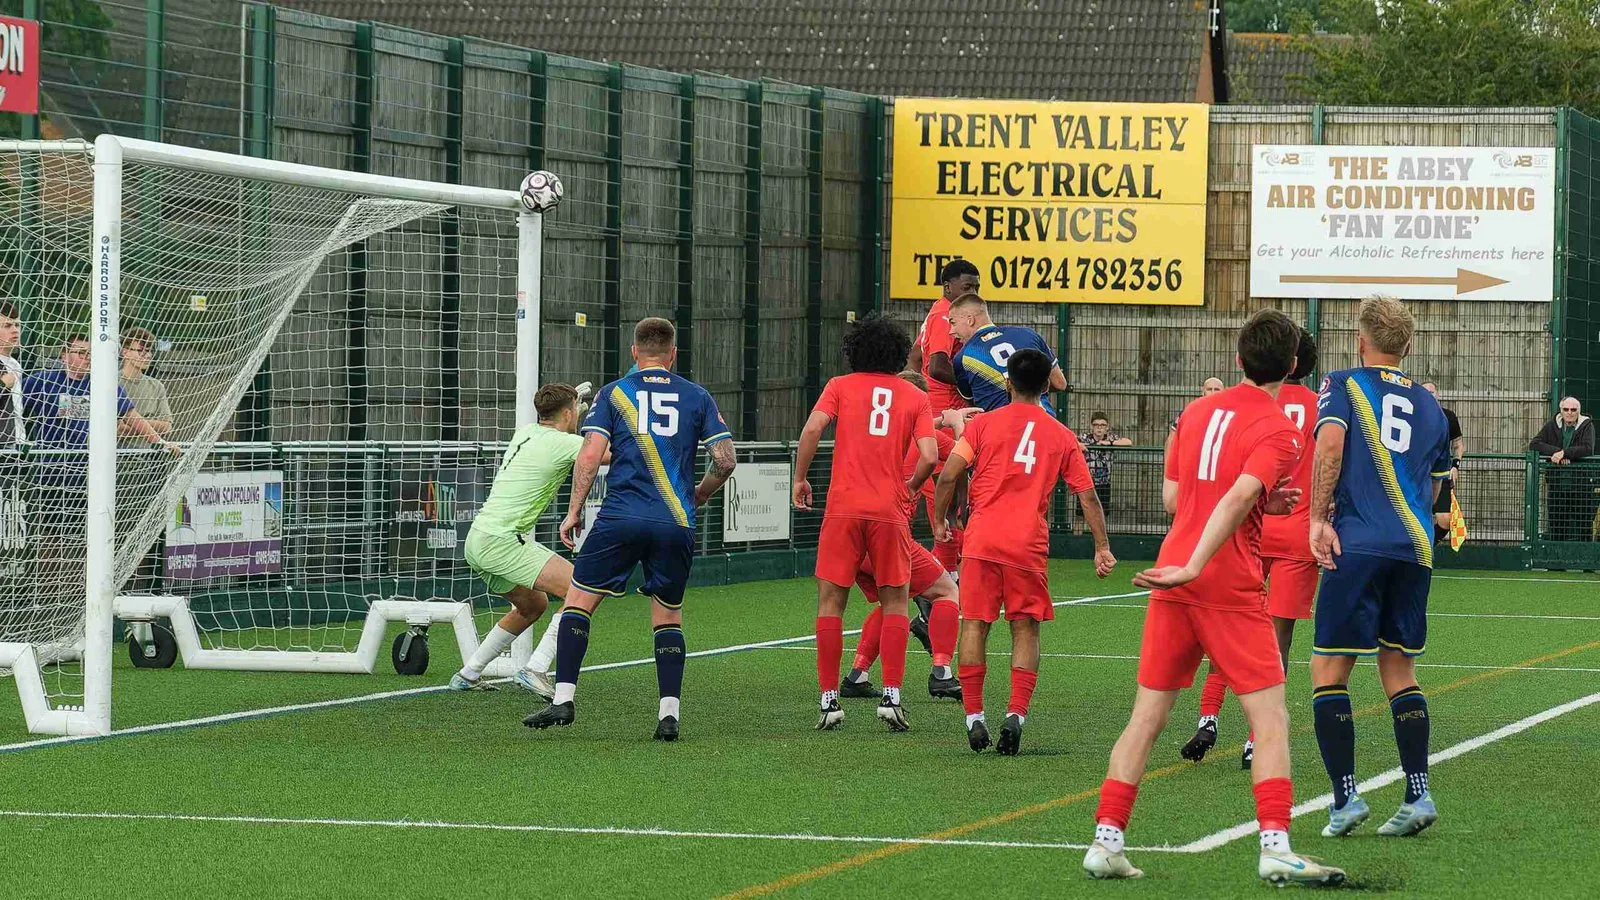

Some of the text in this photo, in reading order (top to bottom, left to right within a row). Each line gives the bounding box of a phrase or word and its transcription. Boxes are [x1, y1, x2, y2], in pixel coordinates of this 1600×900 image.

[915, 111, 1189, 152] TRENT VALLEY
[936, 161, 1162, 199] ELECTRICAL
[1329, 156, 1388, 180] THE
[1397, 157, 1474, 181] ABEY
[1266, 185, 1535, 211] AIR CONDITIONING
[959, 205, 1138, 243] SERVICES
[1257, 244, 1545, 260] Get your Alcoholic Refreshments here
[100, 246, 110, 331] HARROD SPORT
[913, 253, 1183, 292] TE 01724 782356
[1381, 370, 1413, 389] MKM
[636, 390, 680, 437] 15
[869, 386, 893, 436] 8
[1380, 392, 1414, 453] 6
[1013, 421, 1037, 474] 4
[1197, 408, 1236, 482] 11
[197, 485, 260, 506] HORIZON SCAFFOLDING
[740, 504, 772, 515] SOLICITORS
